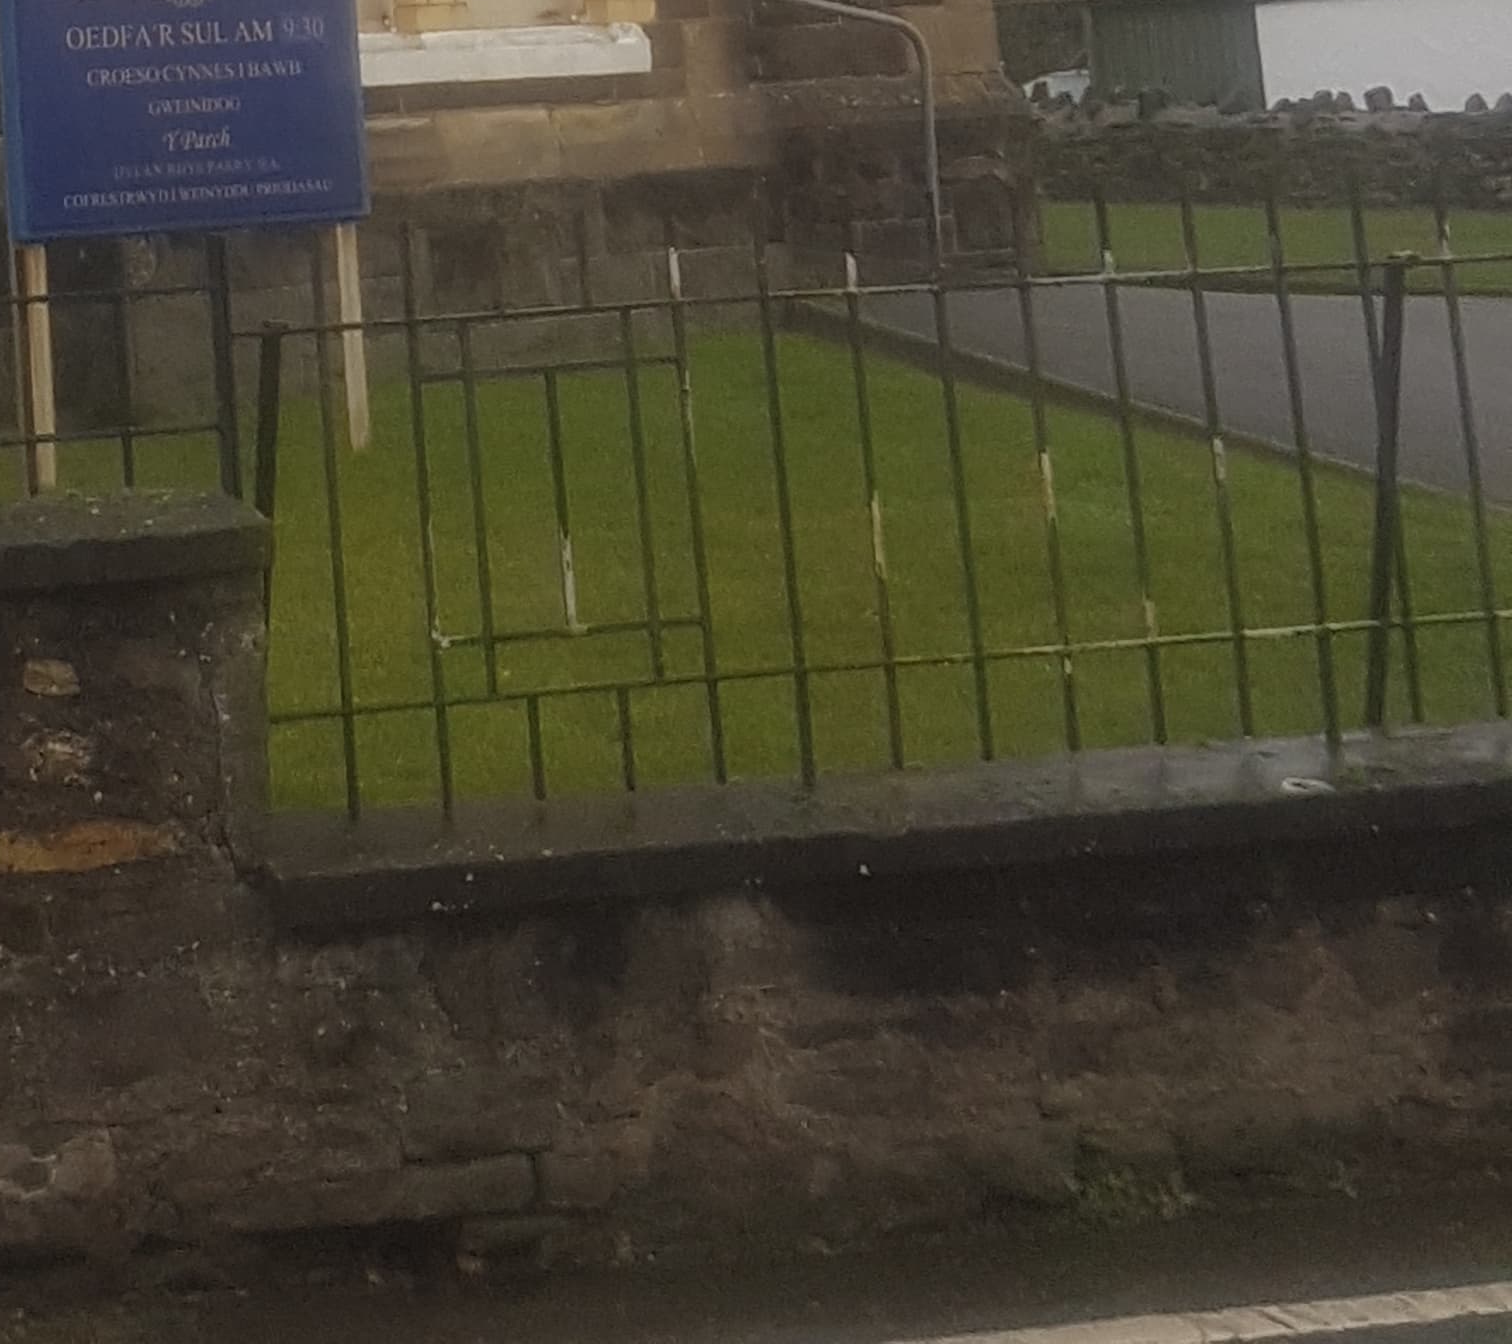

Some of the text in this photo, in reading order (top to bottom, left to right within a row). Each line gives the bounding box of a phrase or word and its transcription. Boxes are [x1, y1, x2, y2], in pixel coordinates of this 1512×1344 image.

[65, 22, 176, 50] OEDFA'R
[180, 21, 228, 46] SUL
[235, 18, 274, 43] AM
